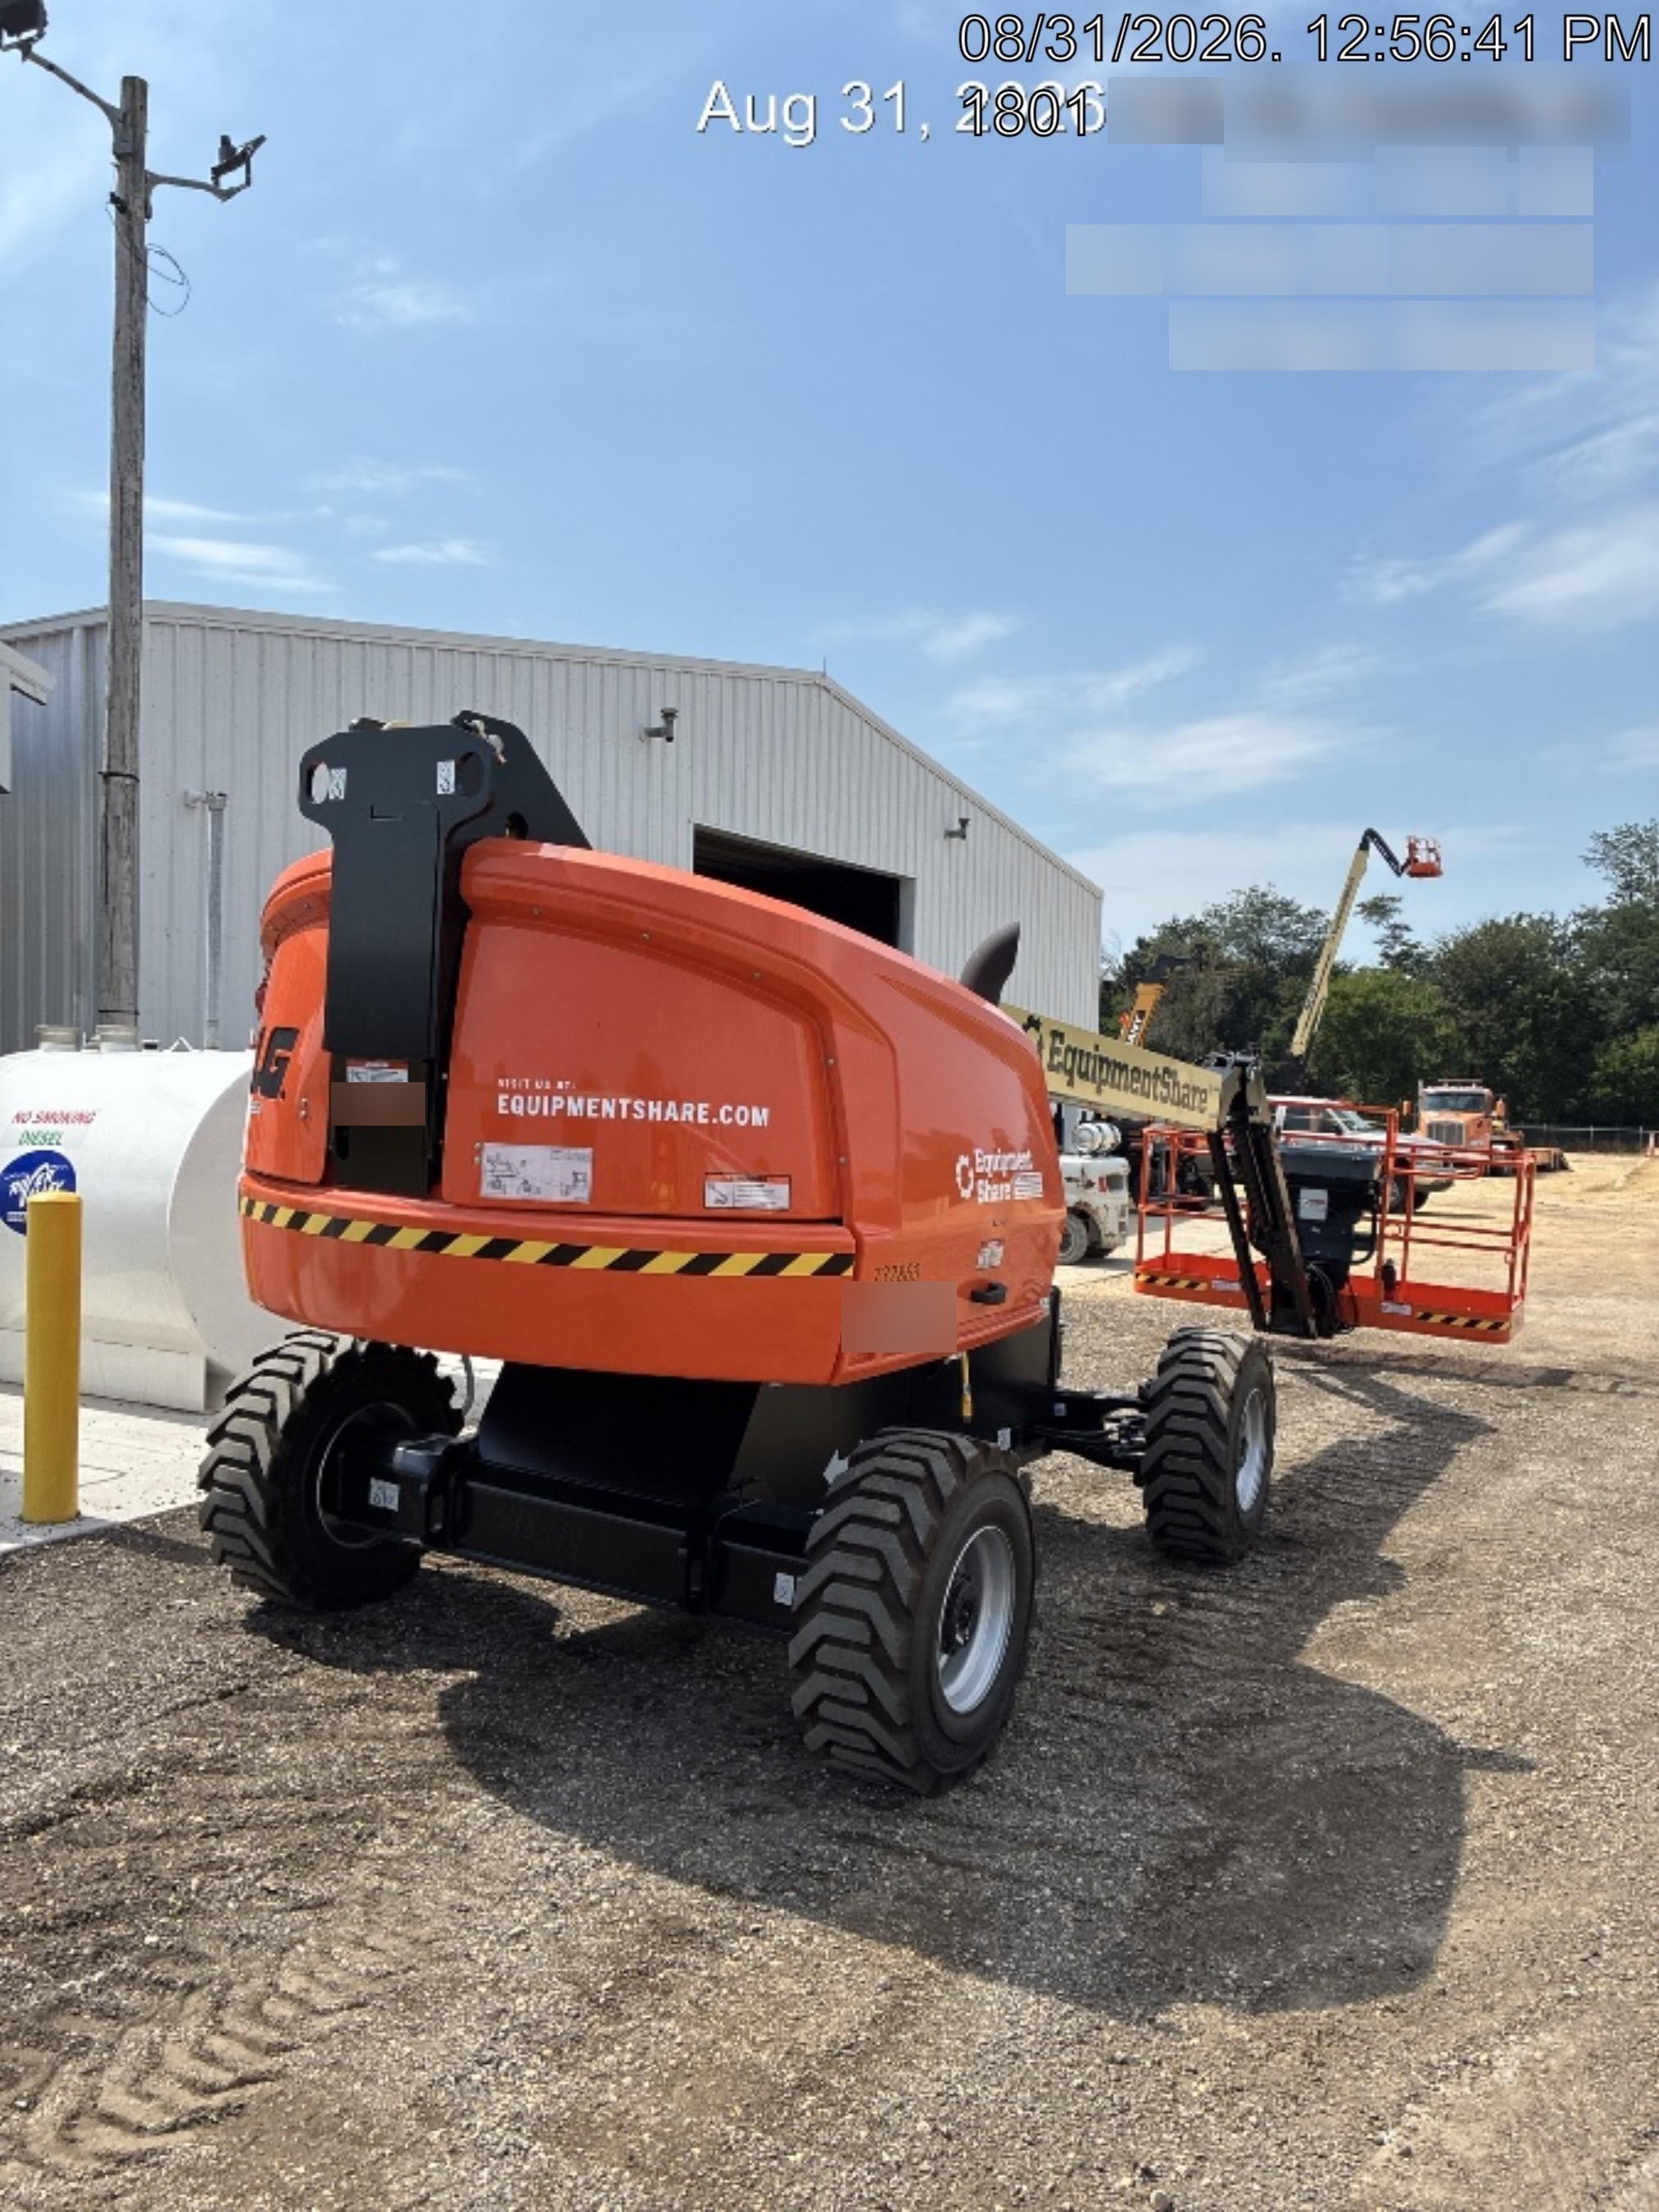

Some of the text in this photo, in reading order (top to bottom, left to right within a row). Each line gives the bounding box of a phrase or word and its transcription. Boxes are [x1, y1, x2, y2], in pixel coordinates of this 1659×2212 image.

[1047, 1029, 1208, 1114] EquipmentShare
[11, 1110, 96, 1124] NO SMOKING
[497, 1092, 770, 1128] EQUIPMENTSHARE.COM
[18, 1130, 63, 1146] DIESEL
[974, 1147, 1032, 1178] Equipment
[977, 1178, 1012, 1204] Share
